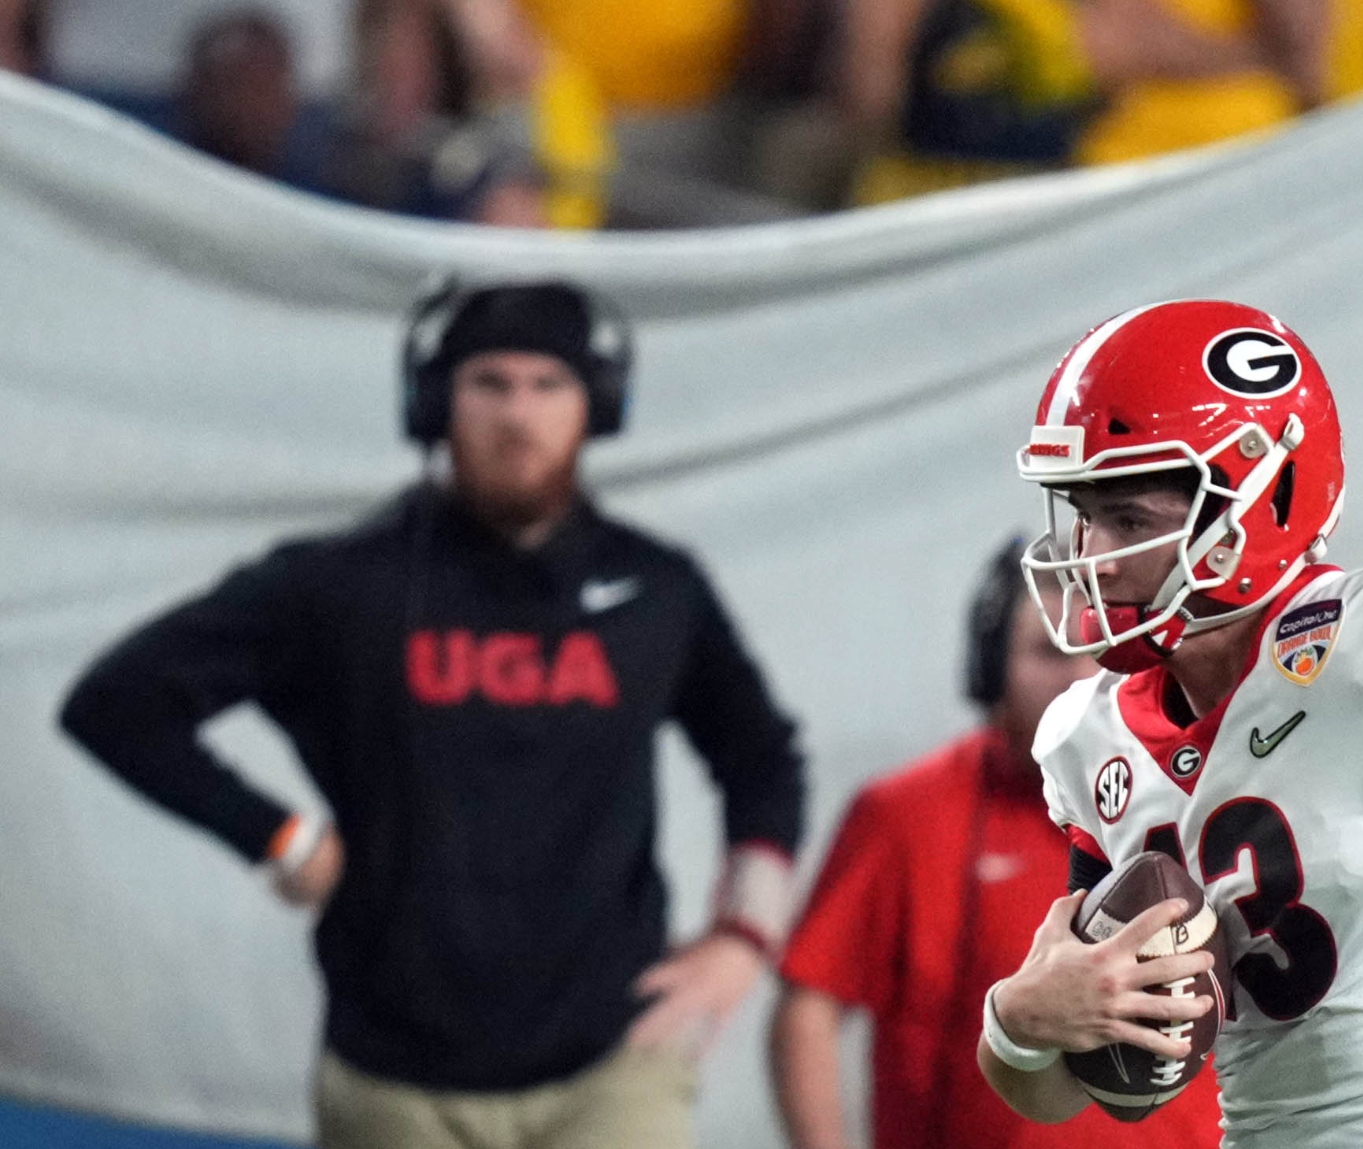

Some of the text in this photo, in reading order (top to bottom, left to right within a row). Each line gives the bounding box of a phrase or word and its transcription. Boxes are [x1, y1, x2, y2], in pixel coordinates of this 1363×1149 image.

[1206, 330, 1299, 395] G
[406, 629, 620, 708] UGA
[1098, 761, 1129, 820] SEC
[1171, 747, 1201, 777] G
